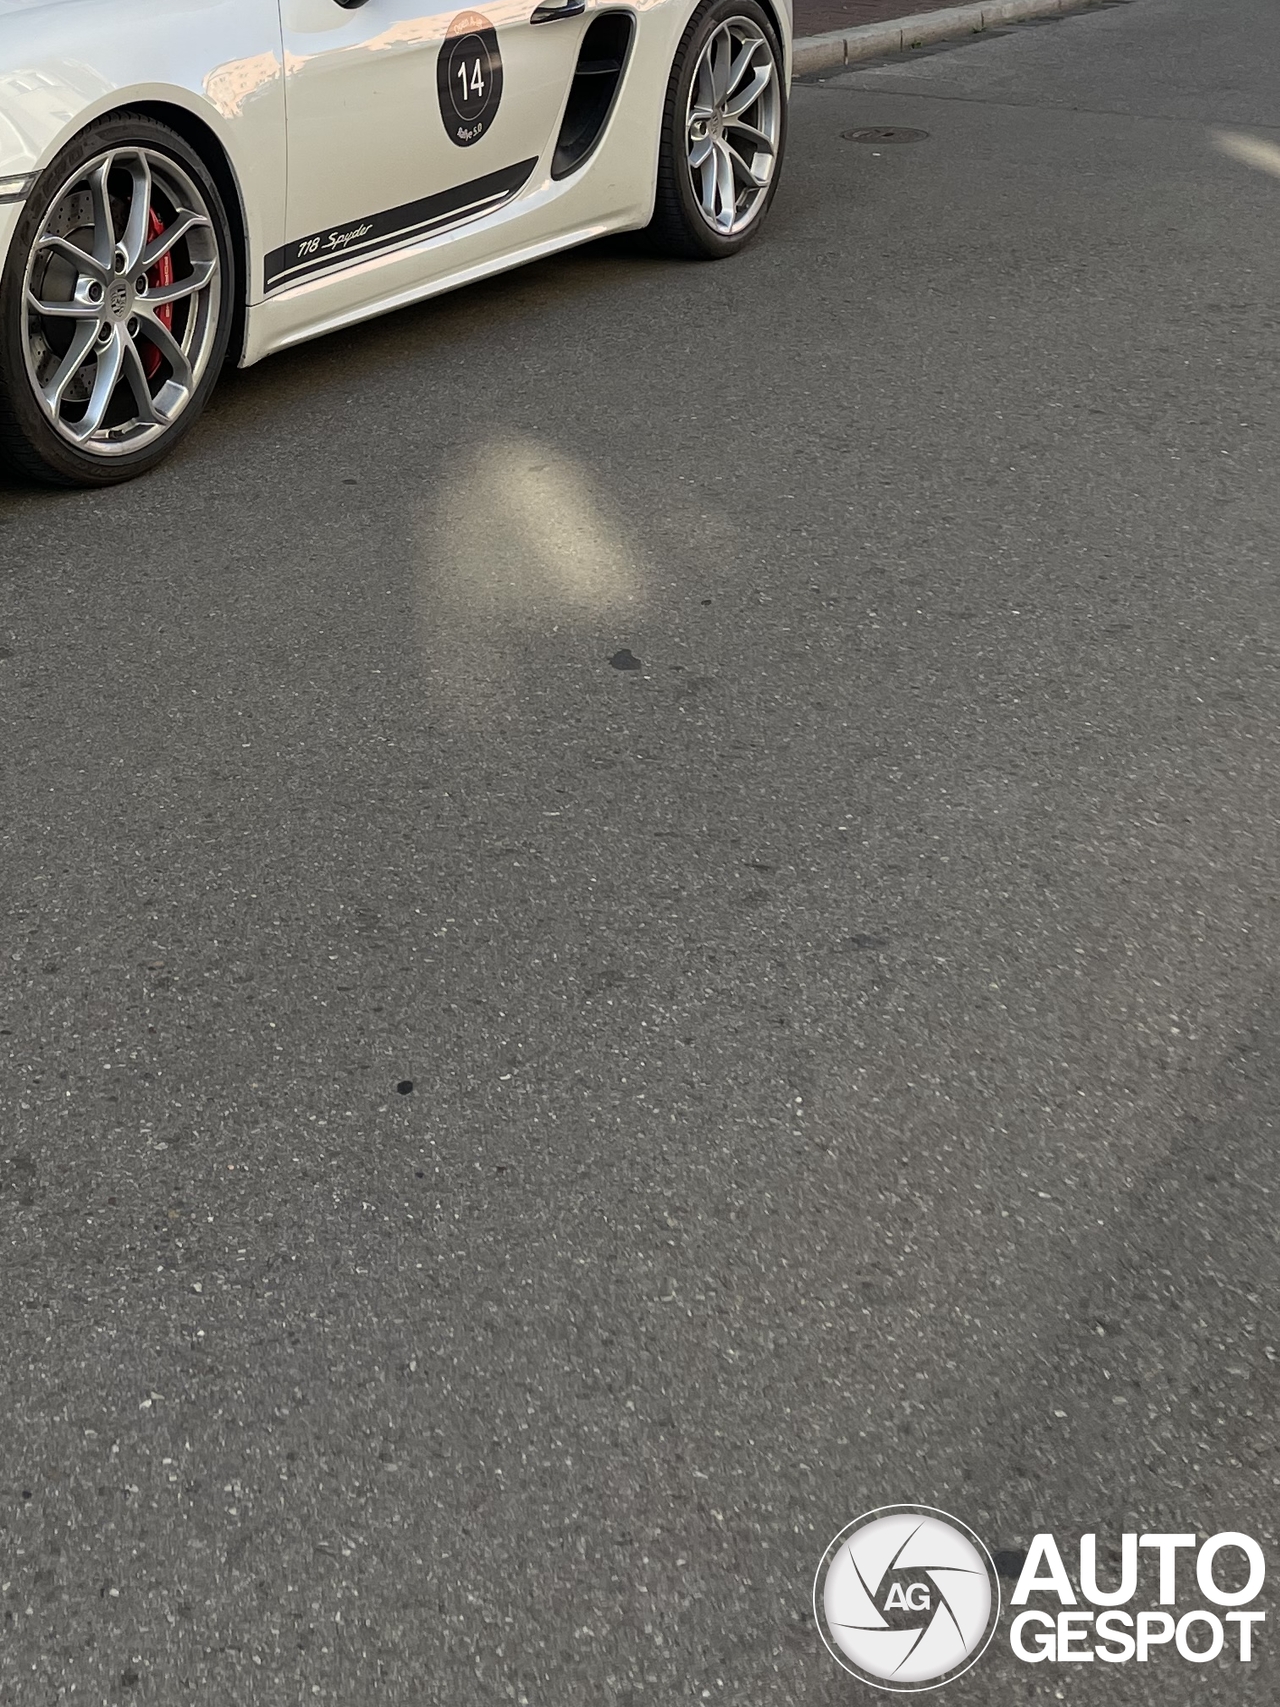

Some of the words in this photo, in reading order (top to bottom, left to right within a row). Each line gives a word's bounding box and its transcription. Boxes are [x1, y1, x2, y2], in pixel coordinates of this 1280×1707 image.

[457, 58, 485, 101] 14
[297, 236, 321, 258] 718
[321, 223, 374, 251] Spyder
